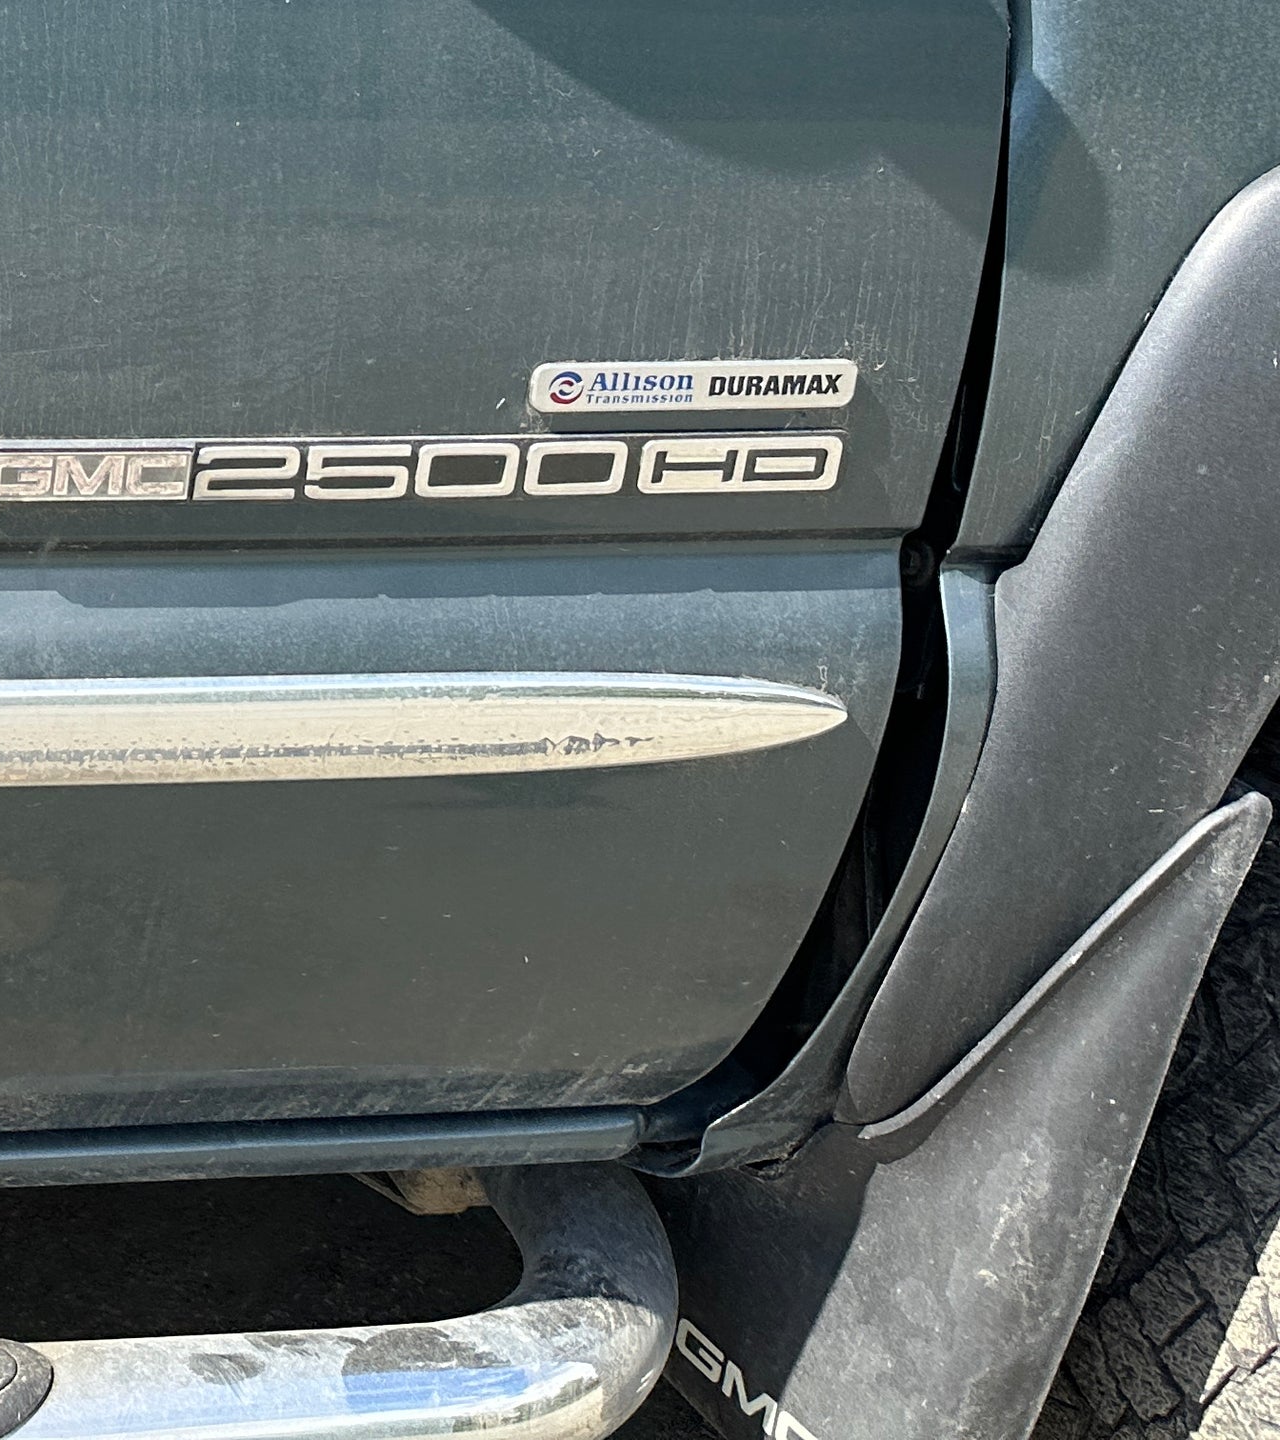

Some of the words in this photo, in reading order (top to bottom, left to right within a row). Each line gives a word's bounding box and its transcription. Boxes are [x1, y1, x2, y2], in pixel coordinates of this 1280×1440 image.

[590, 371, 694, 393] Allison
[708, 373, 844, 398] DURAMAX
[586, 393, 693, 405] Transmission
[192, 440, 629, 501] 2500
[646, 444, 834, 487] HD
